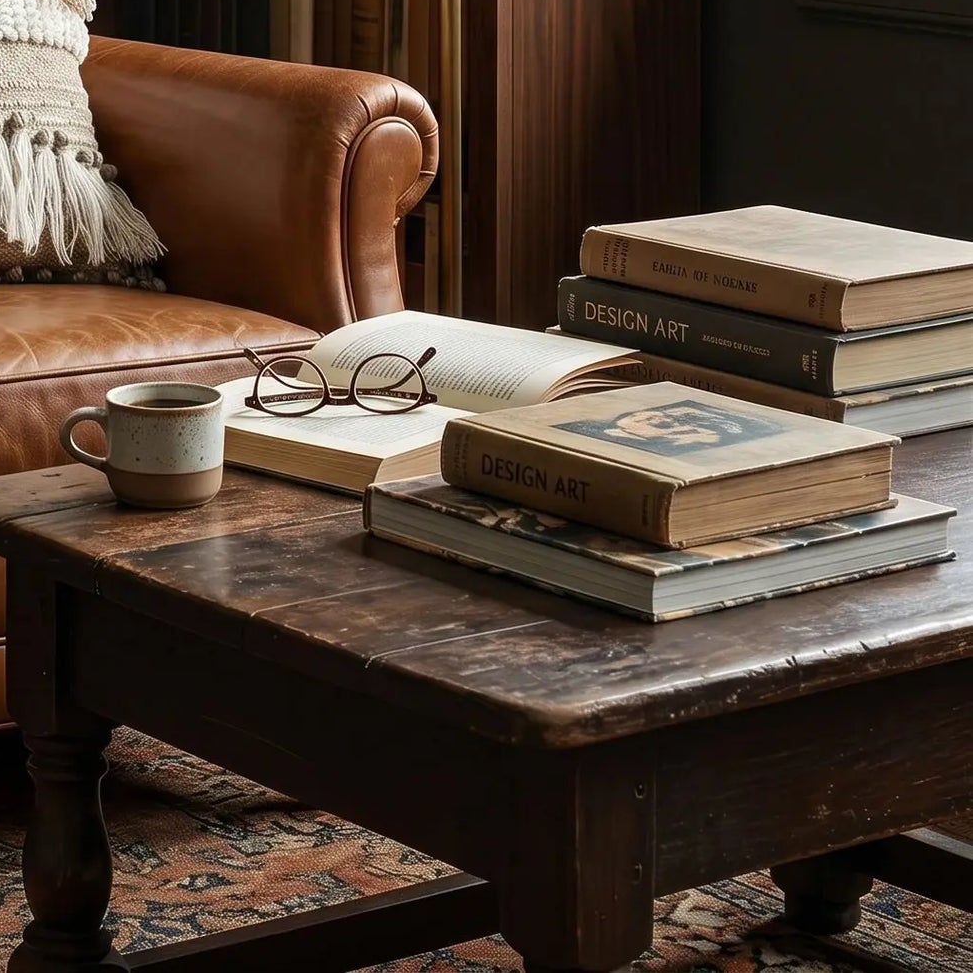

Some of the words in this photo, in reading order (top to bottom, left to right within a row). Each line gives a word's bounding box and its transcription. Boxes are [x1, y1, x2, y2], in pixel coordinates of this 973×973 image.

[584, 301, 650, 335] DESIGN
[653, 317, 690, 343] ART
[481, 453, 548, 492] DESIGN
[554, 476, 590, 504] ART
